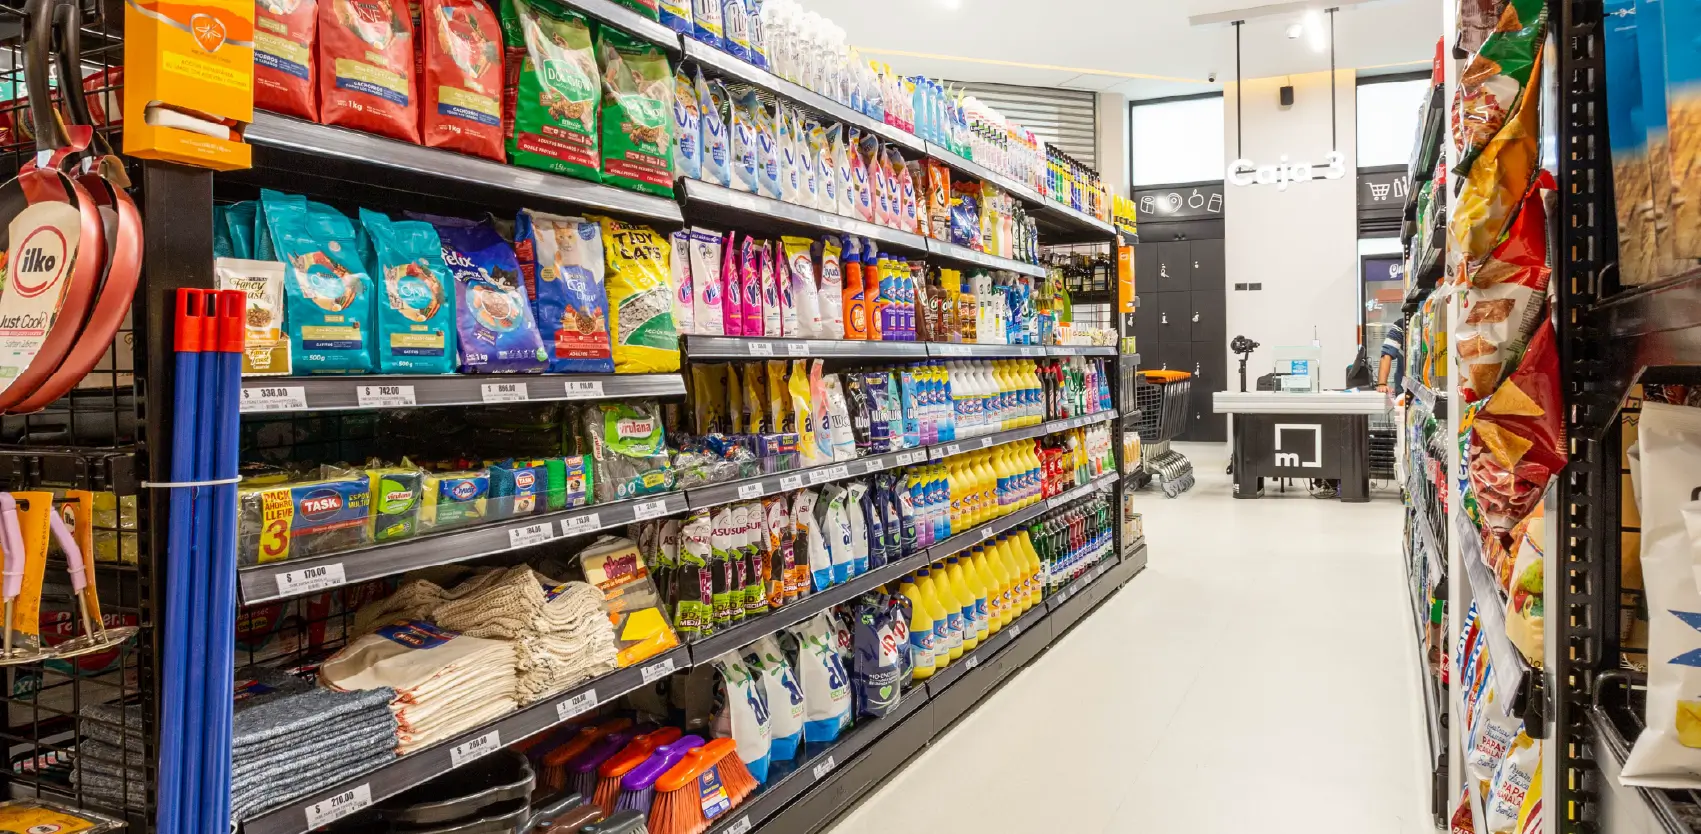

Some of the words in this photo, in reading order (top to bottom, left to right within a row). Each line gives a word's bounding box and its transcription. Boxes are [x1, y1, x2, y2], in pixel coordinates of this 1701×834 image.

[1228, 152, 1313, 192] Caja
[1325, 151, 1347, 180] 3
[612, 231, 653, 248] TIDY
[21, 247, 56, 273] ilko
[620, 245, 662, 261] CATS
[263, 490, 290, 503] PACK
[264, 500, 293, 511] AHORRO
[304, 498, 338, 512] TASK
[265, 508, 293, 521] LLEVE
[263, 519, 288, 556] 3
[1482, 735, 1506, 752] PAPAS
